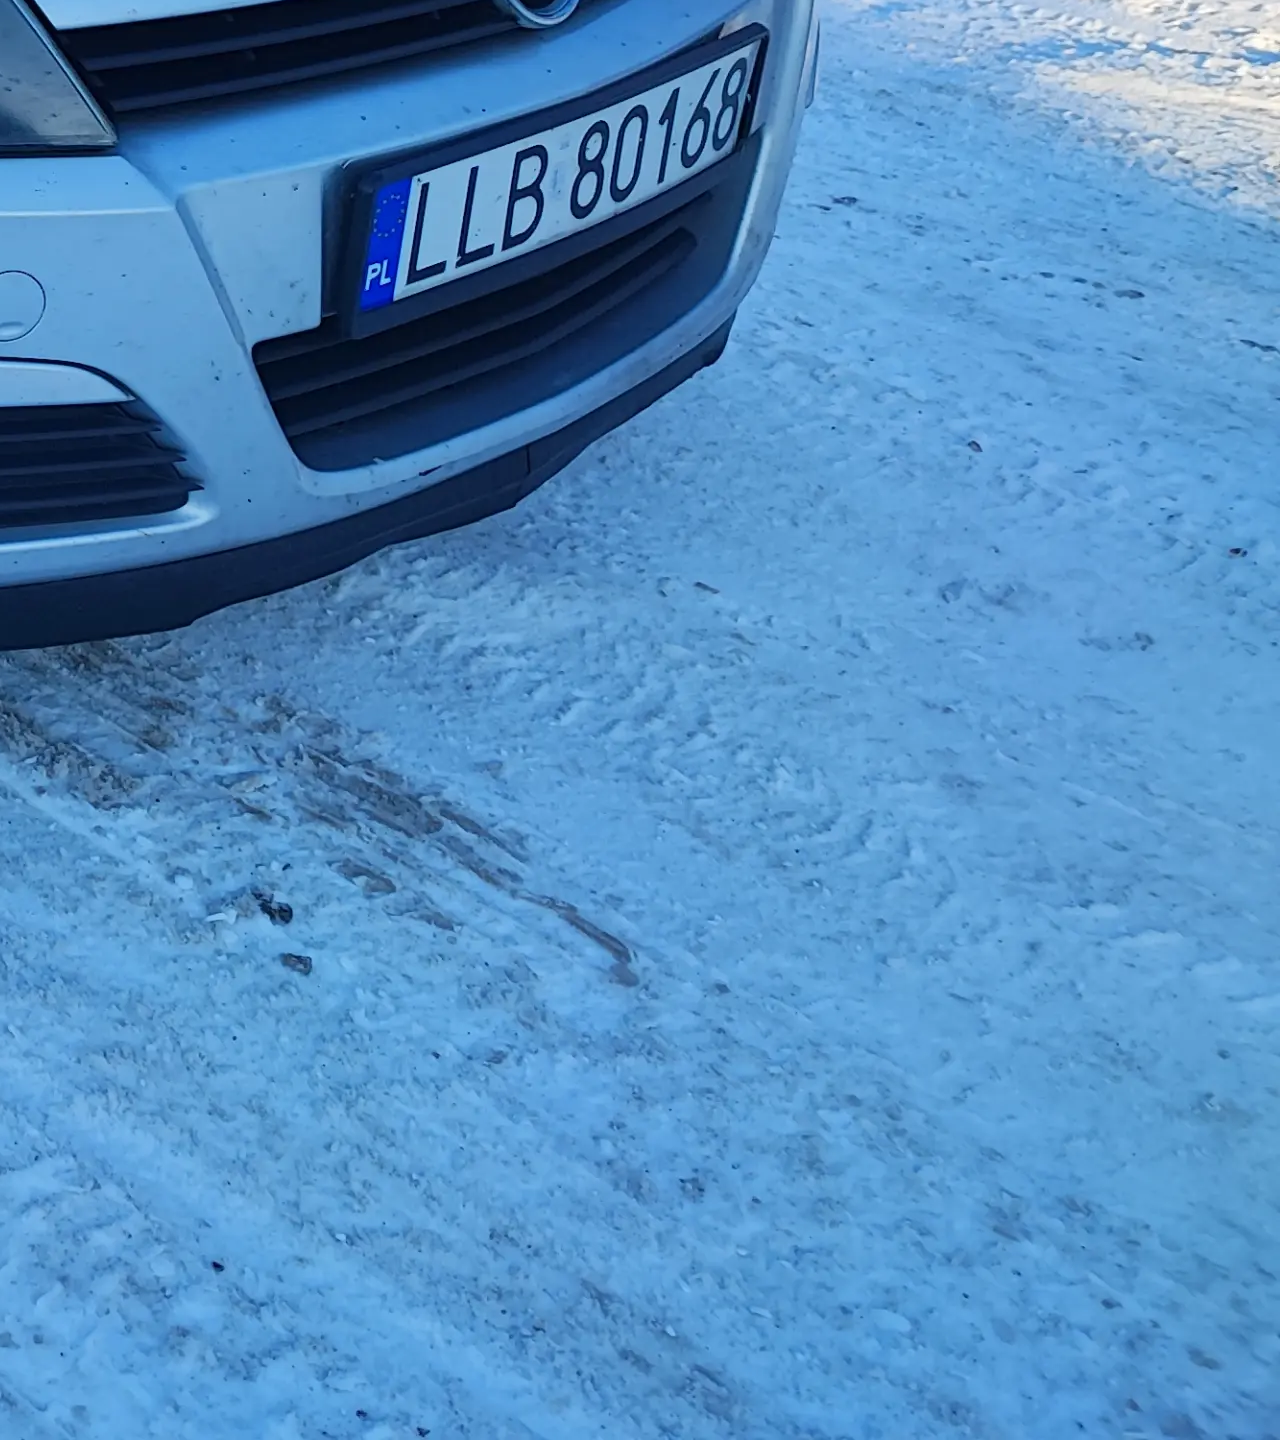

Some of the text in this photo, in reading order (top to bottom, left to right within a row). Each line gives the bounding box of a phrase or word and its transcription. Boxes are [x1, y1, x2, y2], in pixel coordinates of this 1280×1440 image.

[405, 57, 748, 286] LLB 80168
[363, 261, 392, 292] PL
